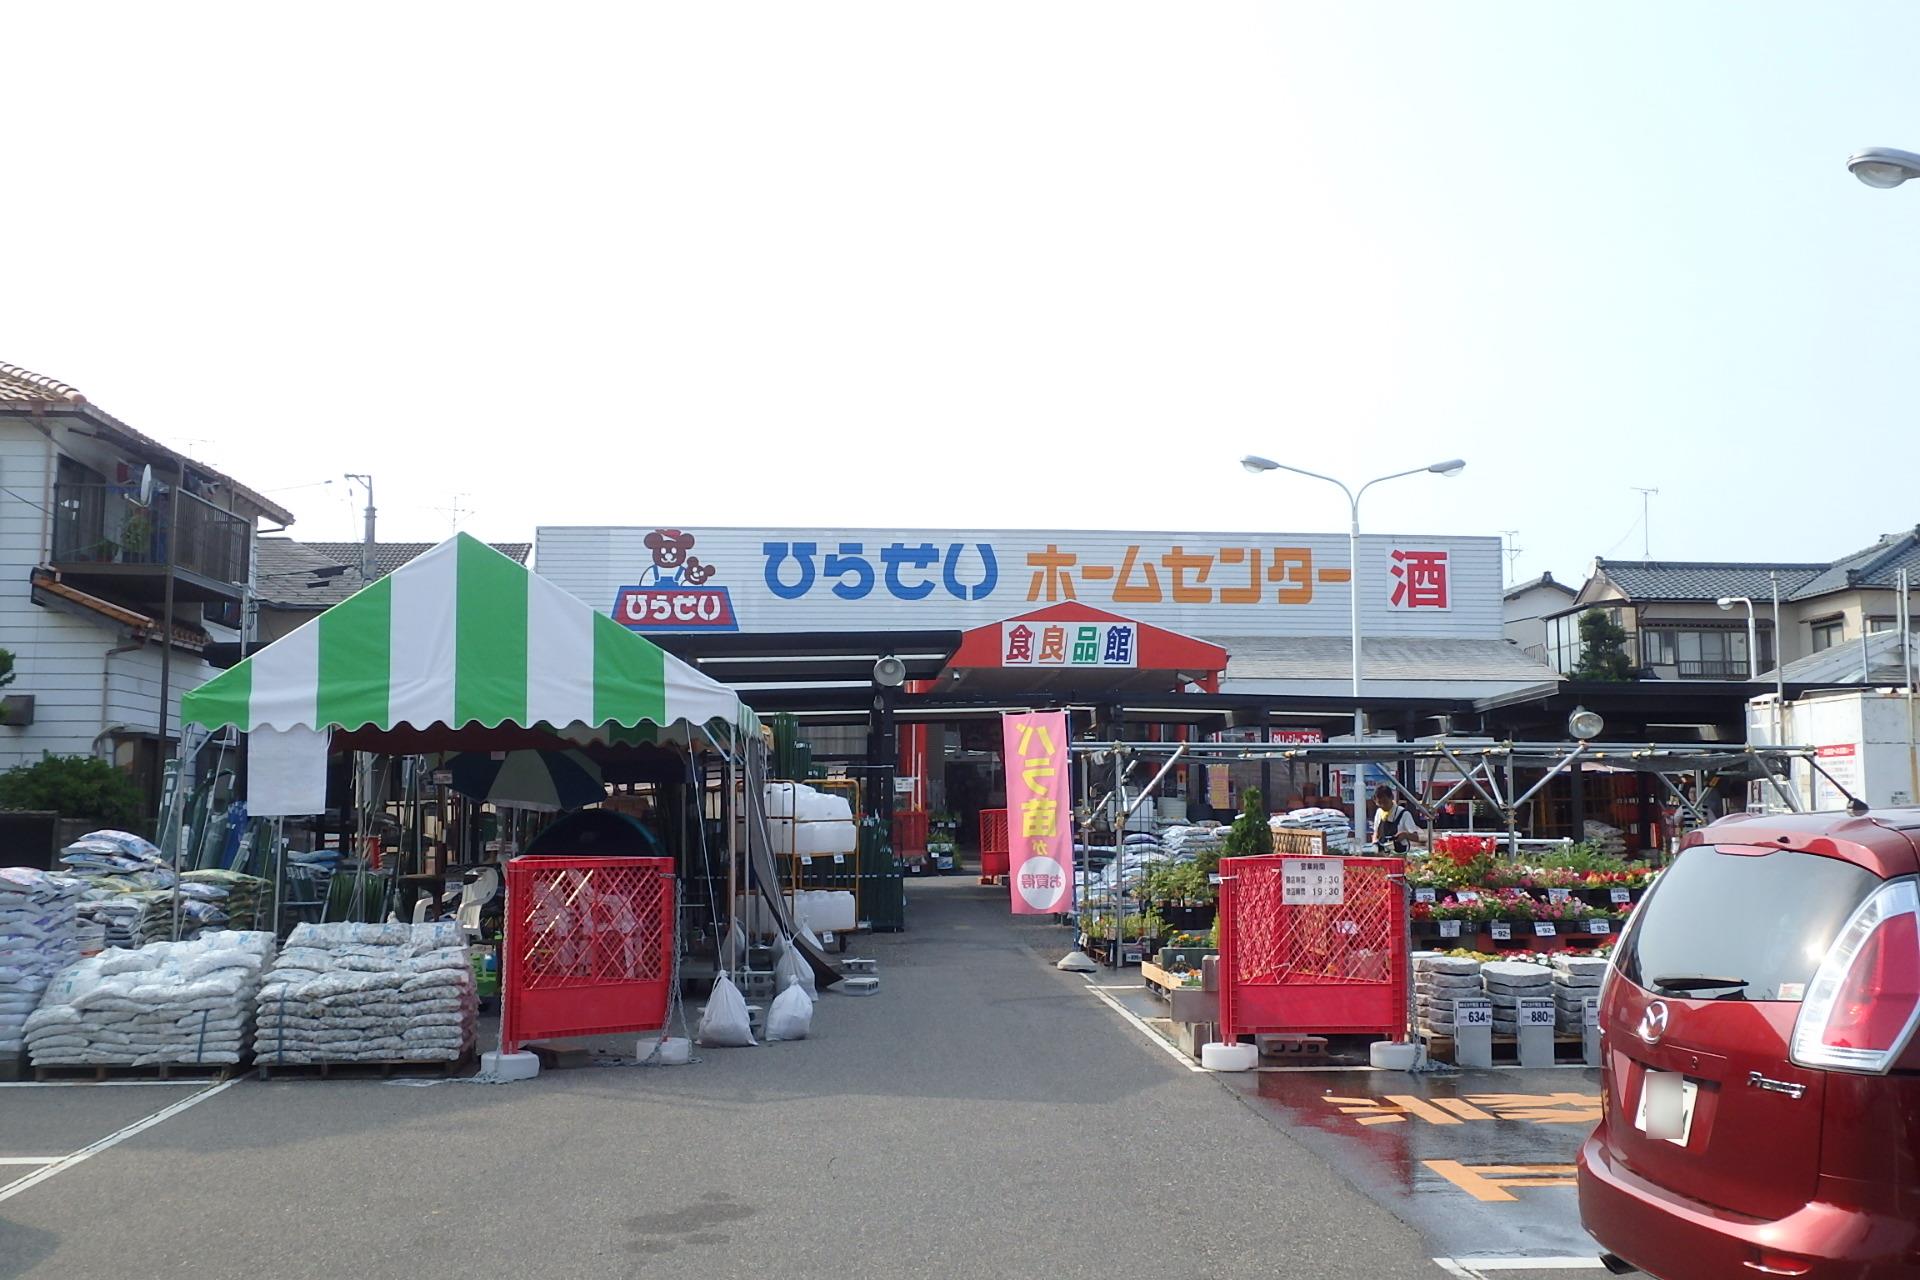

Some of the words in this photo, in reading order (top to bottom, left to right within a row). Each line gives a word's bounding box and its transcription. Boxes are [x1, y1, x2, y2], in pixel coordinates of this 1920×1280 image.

[763, 542, 999, 600] ひらせい
[1026, 544, 1351, 604] ホームセンター
[1390, 549, 1448, 608] 酒
[625, 594, 721, 621] ひらせい
[1005, 624, 1134, 664] 食良品館
[1300, 862, 1326, 871] 営業時間
[1317, 875, 1340, 885] 9:30
[1312, 887, 1340, 896] 19:30
[1468, 1011, 1486, 1023] 634
[1531, 1011, 1549, 1023] 880
